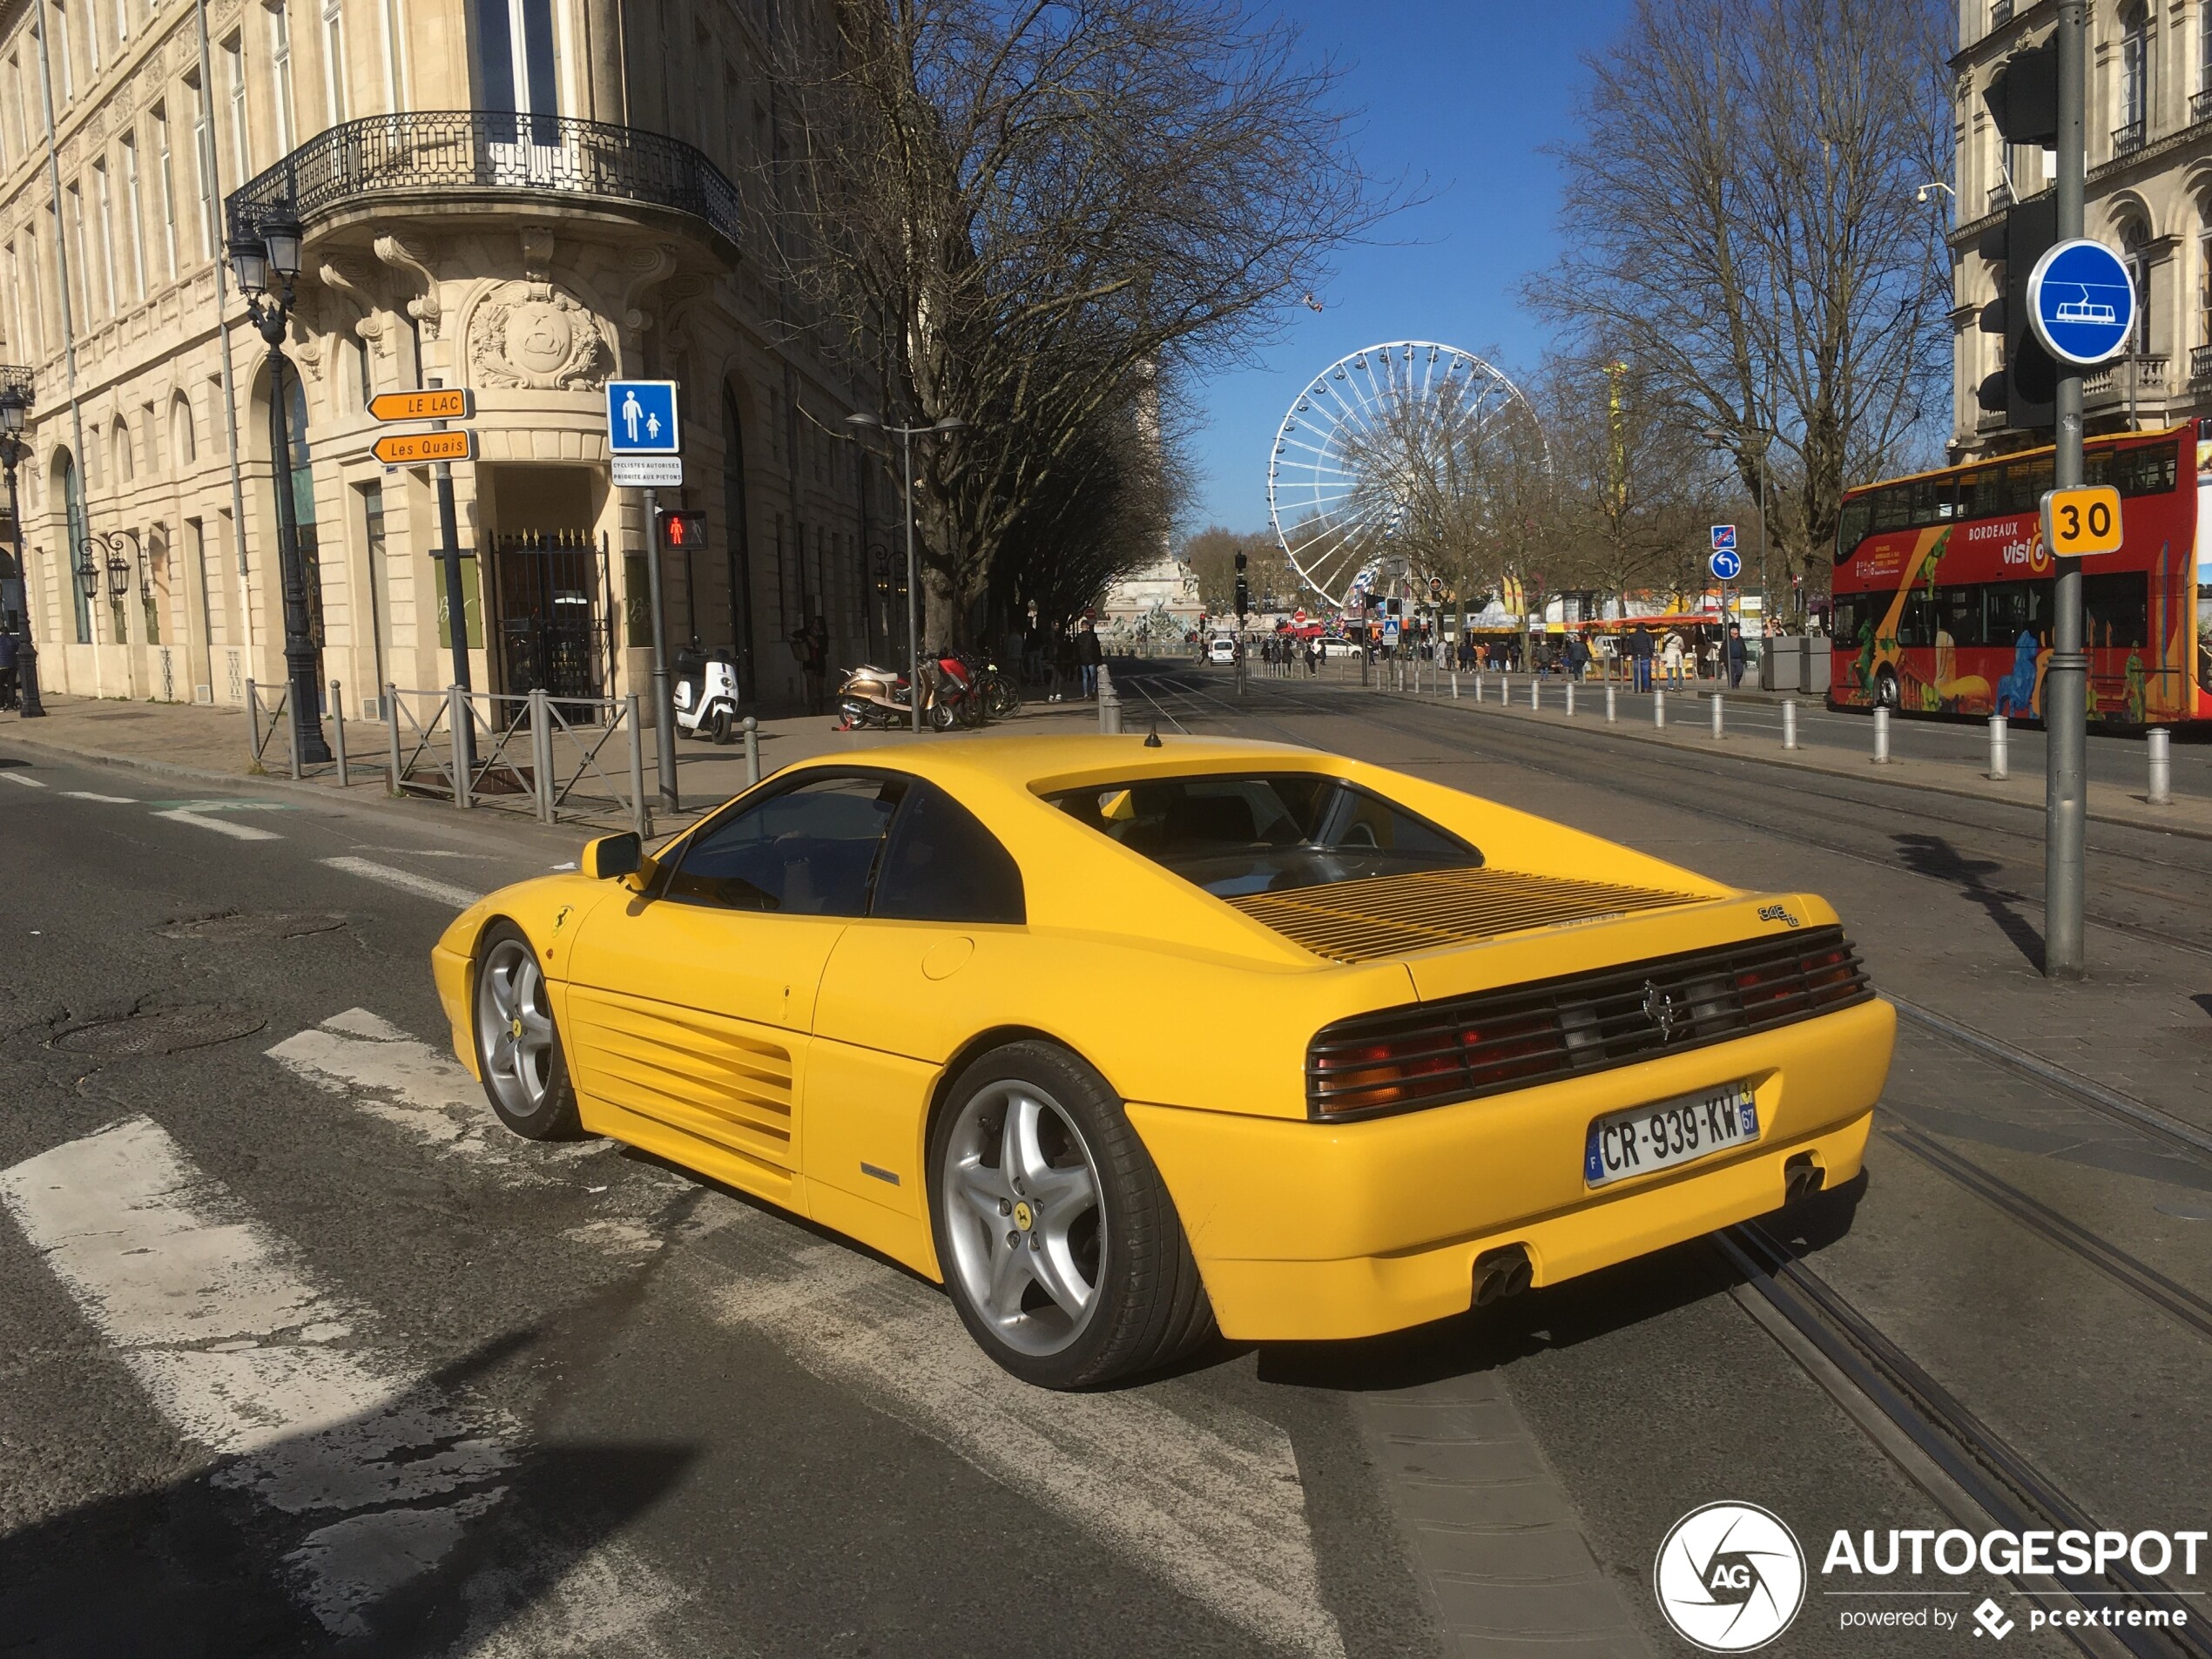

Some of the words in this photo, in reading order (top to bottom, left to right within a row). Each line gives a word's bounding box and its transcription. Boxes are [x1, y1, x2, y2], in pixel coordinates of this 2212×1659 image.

[408, 399, 423, 413] LE
[432, 396, 459, 411] LAC
[391, 442, 414, 456] Les
[421, 438, 463, 454] Quais
[2060, 502, 2111, 541] 30
[1968, 522, 2019, 541] BORDEAUX
[1590, 1156, 1596, 1170] F
[1603, 1093, 1738, 1171] CR-939-KW
[1742, 1108, 1755, 1130] 67
